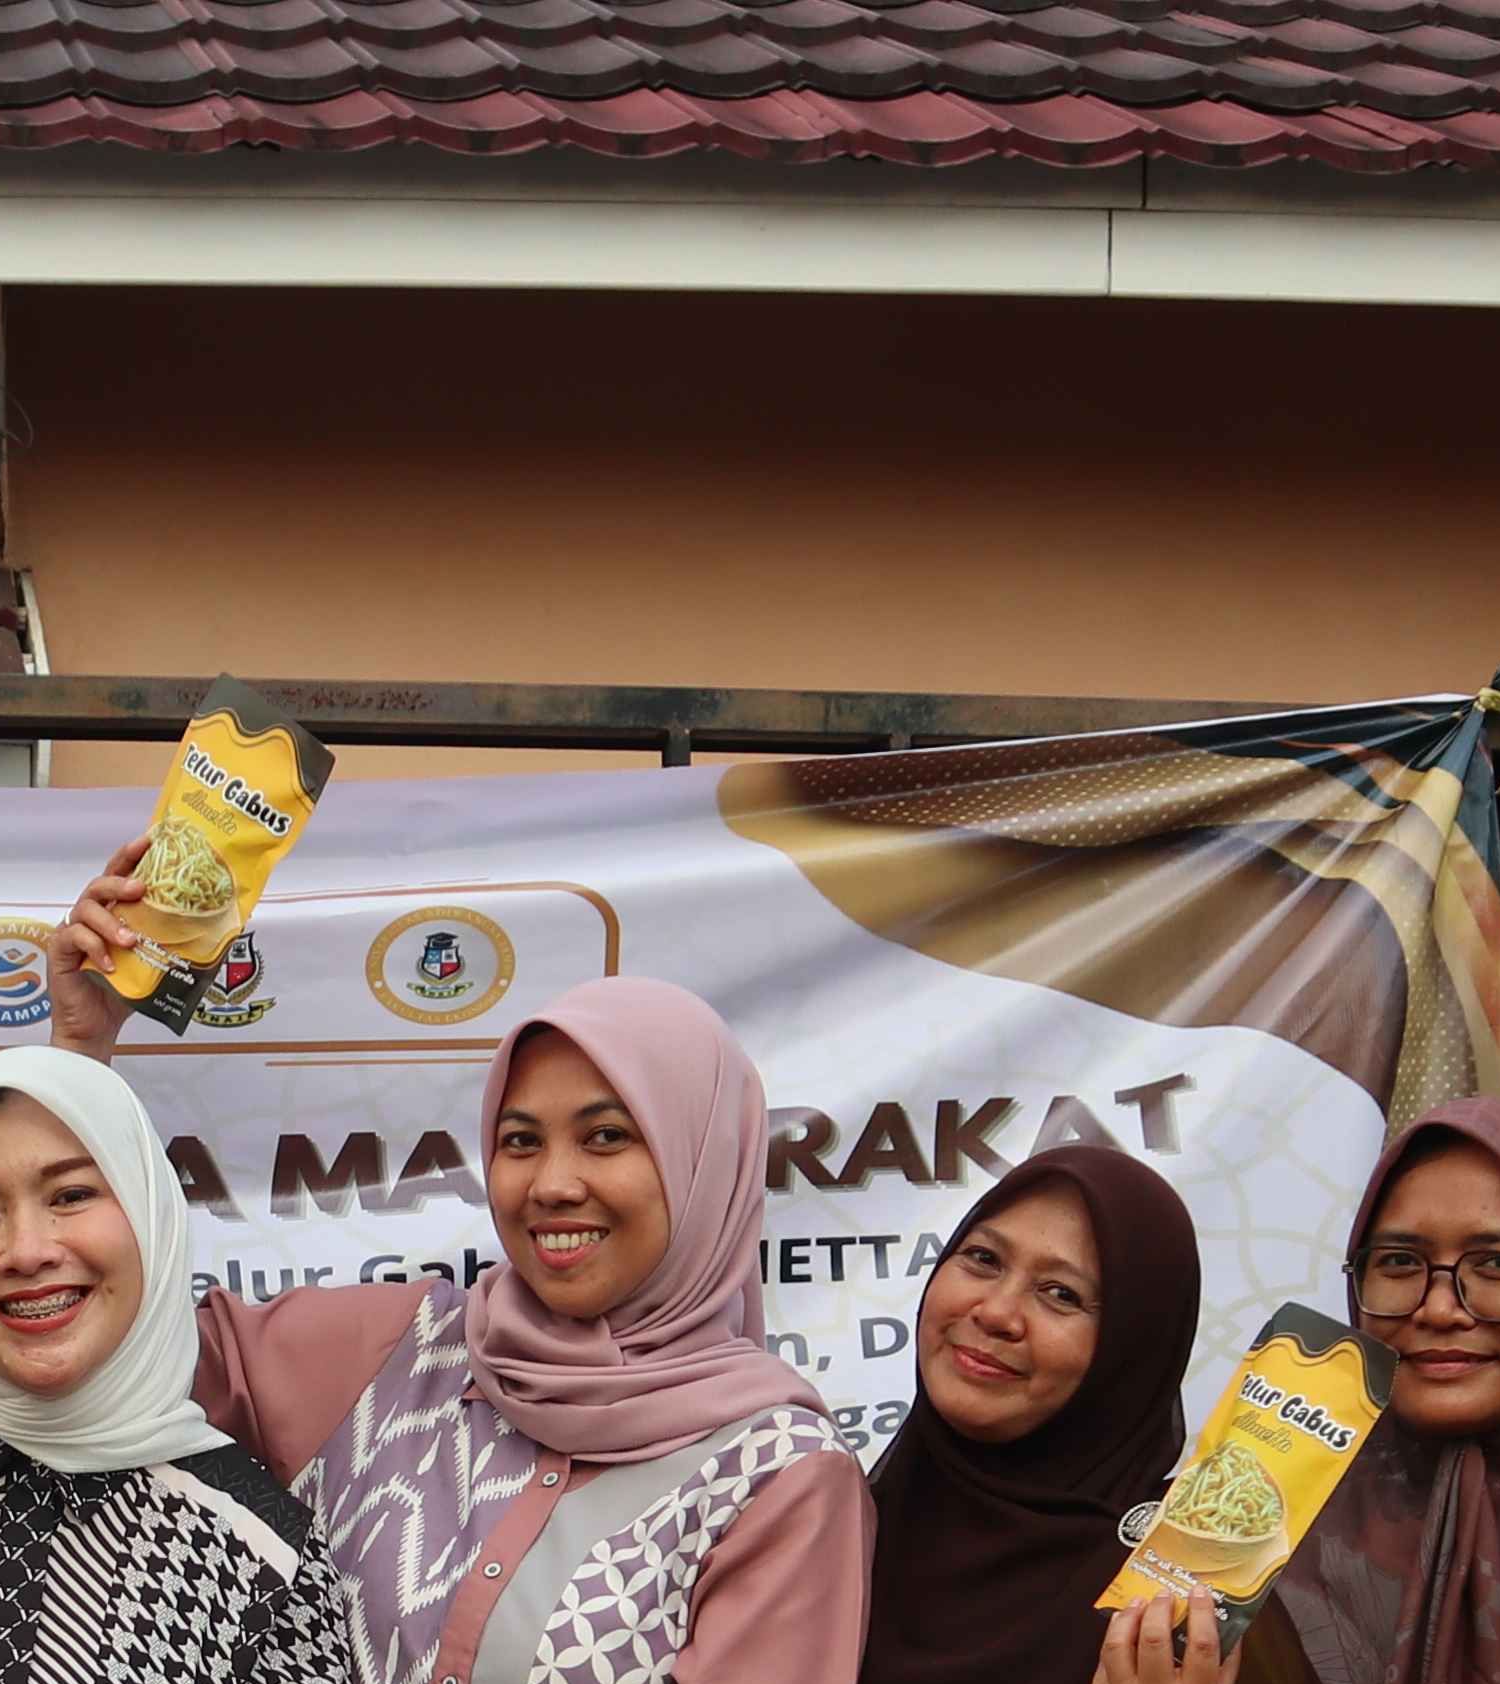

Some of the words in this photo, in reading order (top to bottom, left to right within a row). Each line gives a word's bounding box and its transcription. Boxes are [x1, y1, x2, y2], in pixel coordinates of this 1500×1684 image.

[223, 777, 292, 836] Gabus
[191, 1258, 334, 1304] elur
[1242, 1373, 1281, 1410] elur
[1279, 1394, 1355, 1452] Gabus
